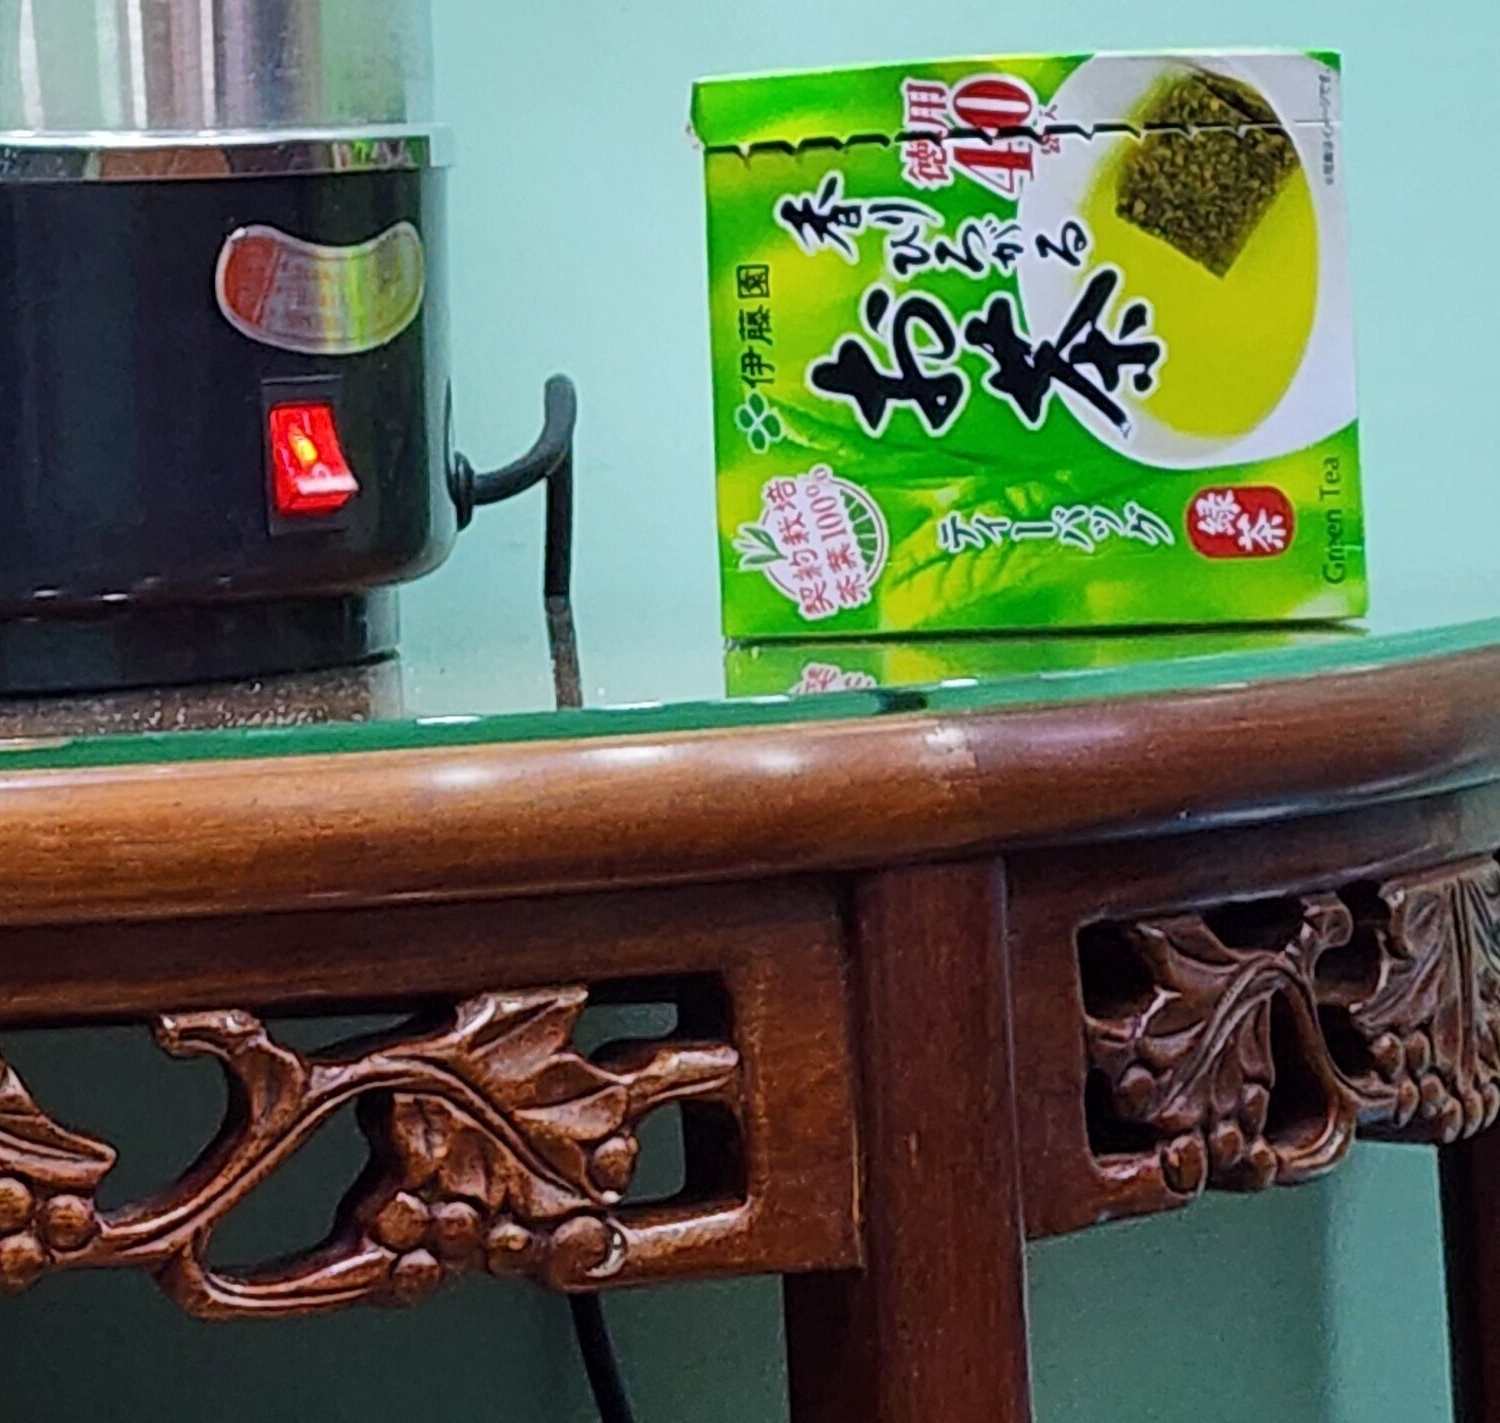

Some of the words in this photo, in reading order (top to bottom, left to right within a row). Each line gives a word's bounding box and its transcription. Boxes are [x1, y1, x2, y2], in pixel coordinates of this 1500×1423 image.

[953, 80, 1035, 193] 40
[737, 265, 774, 388] 伊藤園
[812, 271, 1160, 432] お茶
[1196, 492, 1288, 550] 緑茶
[1318, 457, 1340, 501] Tea
[765, 480, 834, 614] 契約栽培
[1323, 508, 1345, 584] Green
